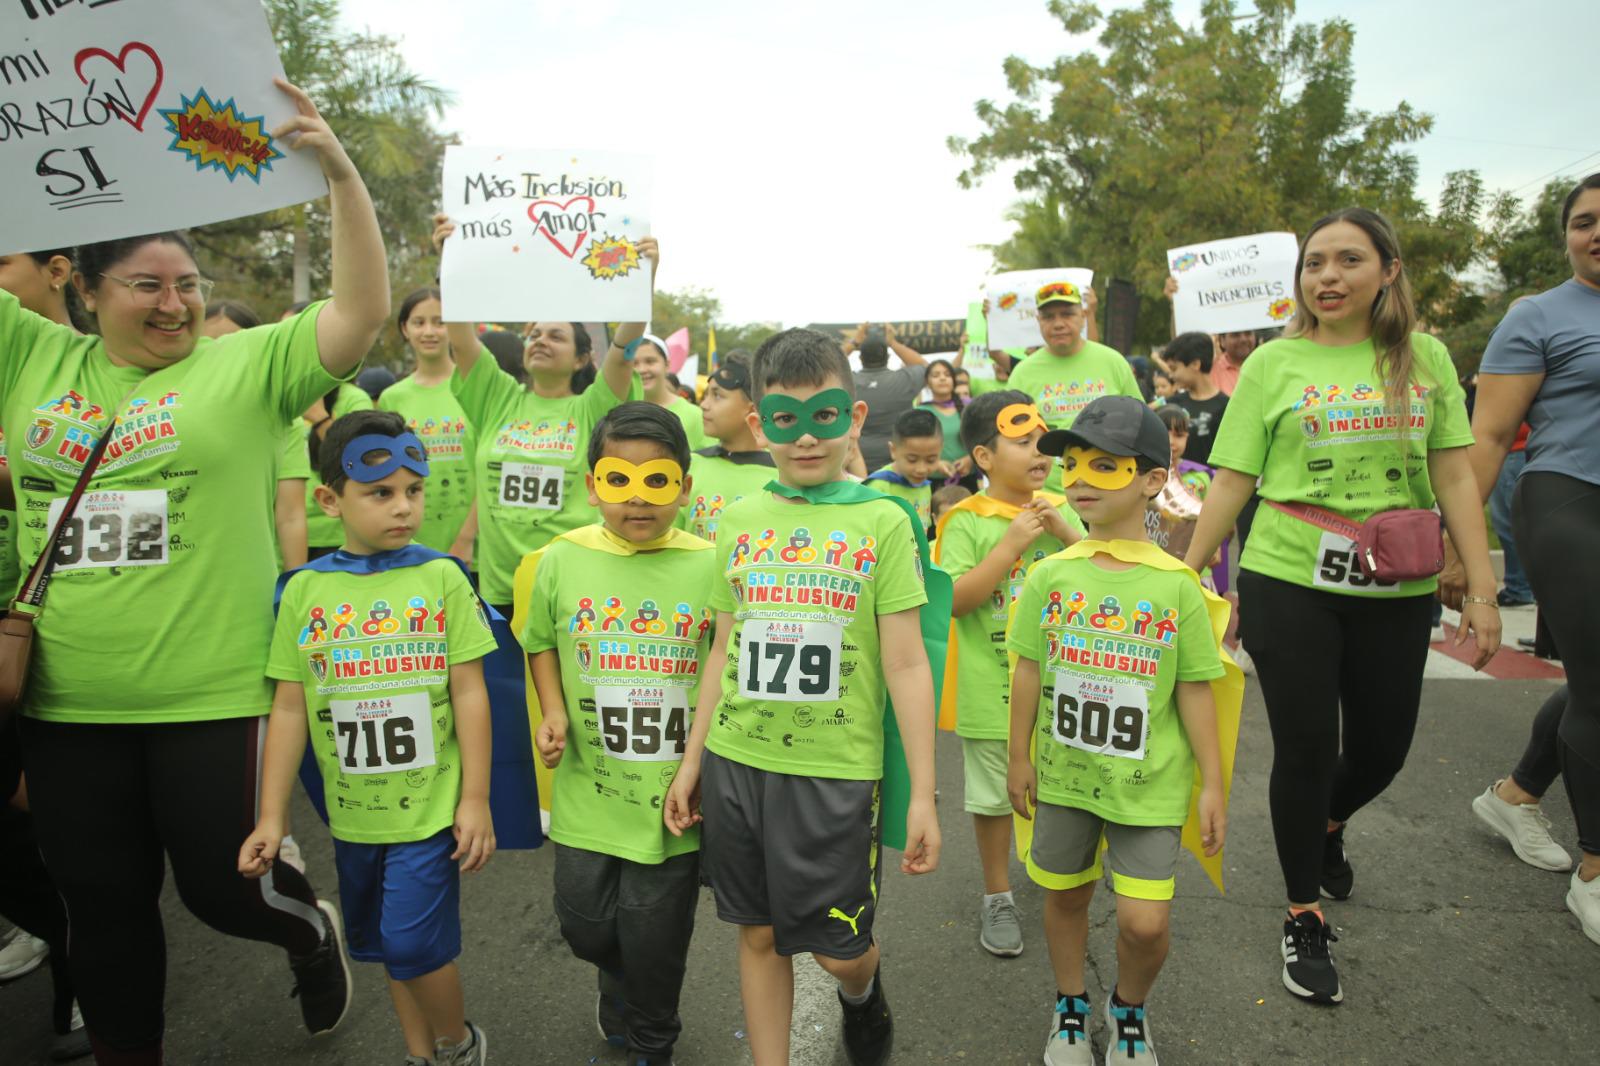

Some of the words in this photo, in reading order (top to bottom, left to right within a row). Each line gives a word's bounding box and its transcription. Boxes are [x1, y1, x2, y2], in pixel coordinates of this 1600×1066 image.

[36, 146, 118, 196] SI
[464, 172, 516, 206] Más
[521, 172, 627, 200] Inclusión,
[462, 212, 512, 240] más
[504, 475, 559, 506] 694
[52, 513, 163, 566] 932
[748, 573, 775, 585] 5ta
[786, 573, 861, 594] CARRERA
[748, 587, 856, 611] INCLUSIVA
[333, 648, 362, 661] 5ta
[371, 642, 447, 658] CARRERA
[599, 640, 629, 654] 5ta
[1060, 647, 1157, 676] INCLUSIVA
[1061, 633, 1086, 648] 5ta
[1094, 638, 1161, 661] CARRERA
[334, 655, 447, 678] INCLUSIVA
[599, 655, 698, 675] INCLUSIVA
[747, 641, 832, 695] 179
[601, 707, 687, 755] 554
[1057, 693, 1143, 752] 609
[337, 716, 417, 767] 716
